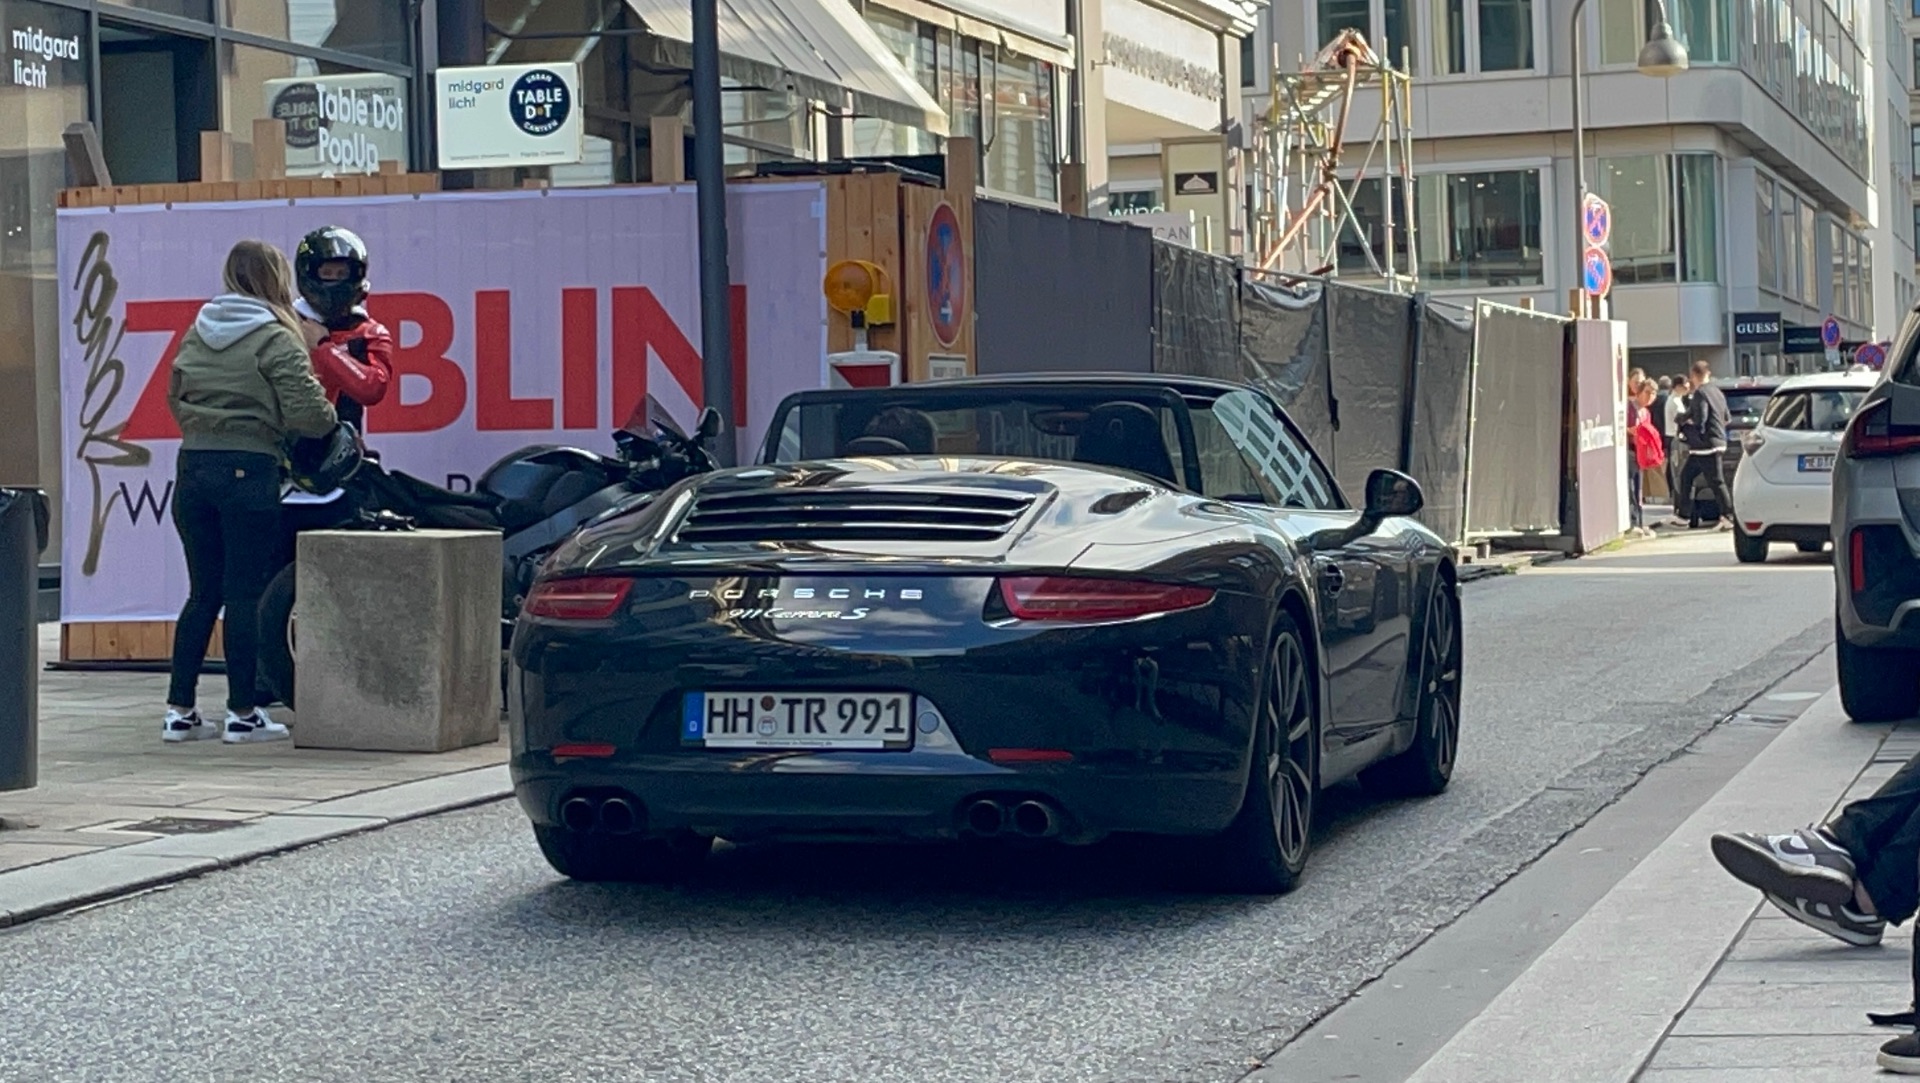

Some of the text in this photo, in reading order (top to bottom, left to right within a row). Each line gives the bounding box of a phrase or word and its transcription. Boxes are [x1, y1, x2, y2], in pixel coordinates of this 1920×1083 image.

[12, 26, 79, 61] midgard
[14, 58, 47, 89] licht
[448, 78, 505, 94] midgard
[448, 96, 476, 109] licht
[516, 88, 563, 105] TABLE
[315, 83, 404, 132] Table Dot
[525, 104, 553, 119] DOT
[318, 127, 380, 177] PopUp
[1736, 322, 1779, 334] GUESS
[119, 284, 748, 440] ZBLIN
[688, 588, 923, 600] PORSCHE
[728, 607, 870, 620] 911 Carrera S
[707, 698, 906, 735] HH TR 991
